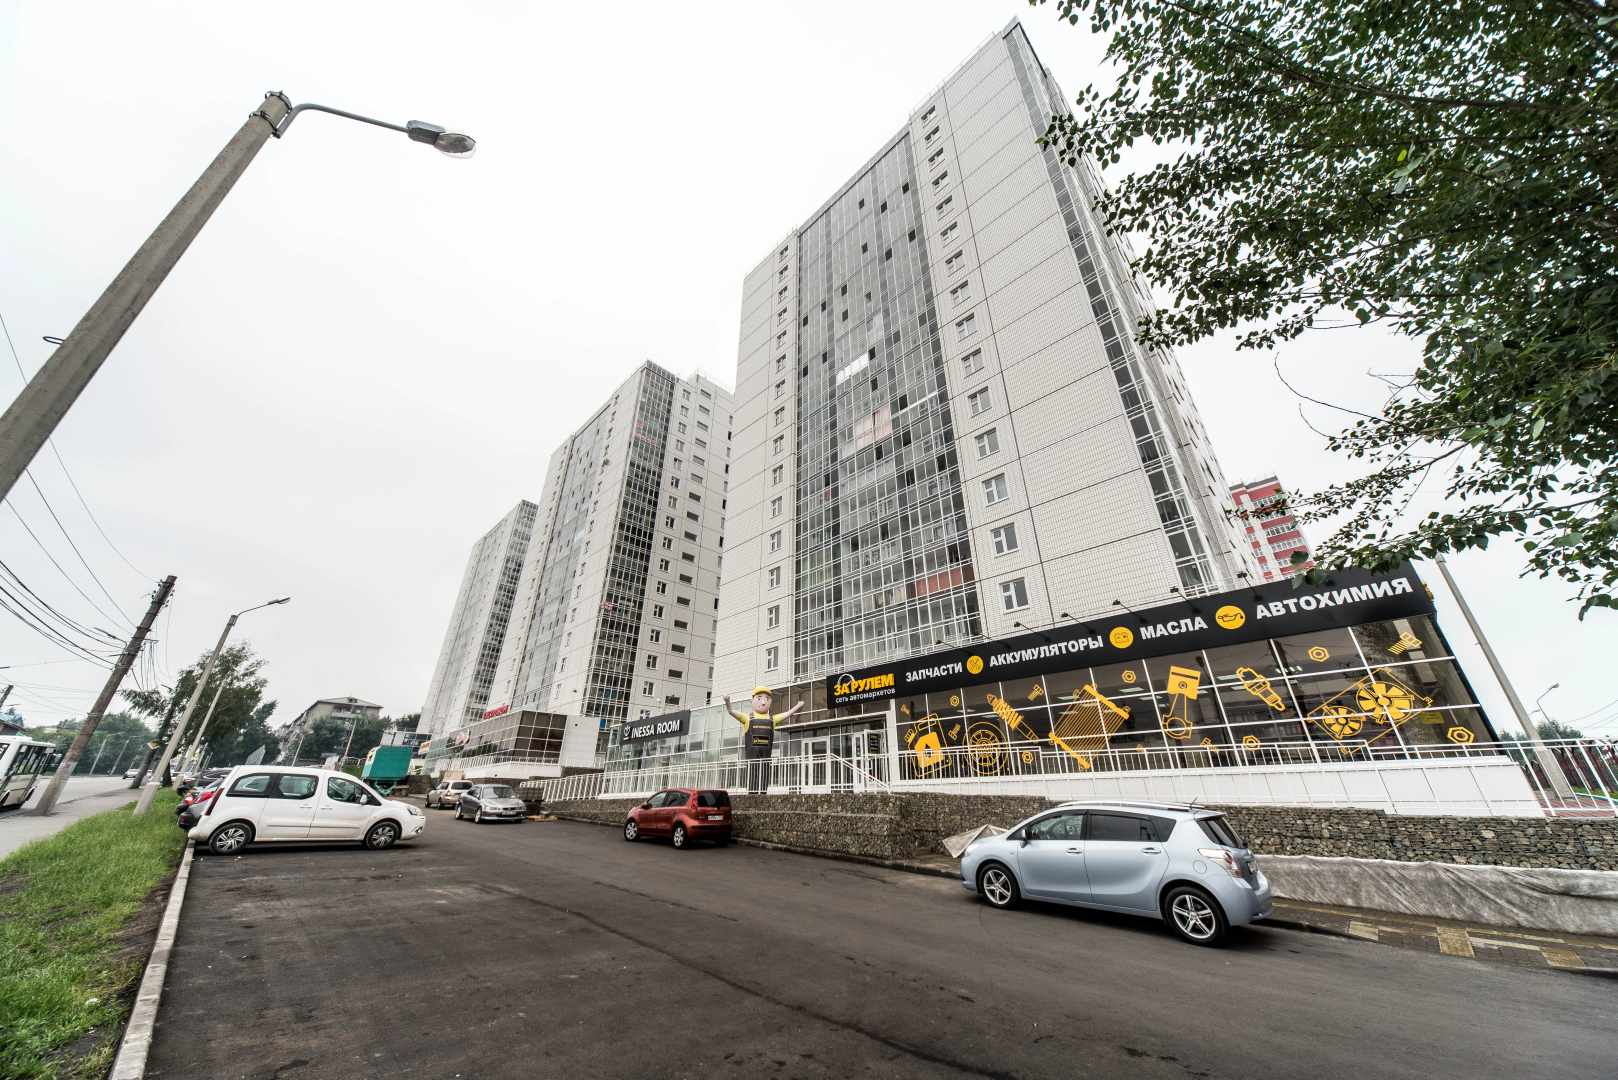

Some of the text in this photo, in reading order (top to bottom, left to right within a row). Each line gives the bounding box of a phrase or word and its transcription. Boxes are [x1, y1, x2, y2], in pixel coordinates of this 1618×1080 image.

[905, 577, 1414, 683] ЗАПЧАСТИ АККУМУЛЯТОРЫ МАСЛА АВТОХИМИЯ
[834, 673, 895, 696] ЗА РУЛЕМ
[849, 687, 896, 702] автомаркетов
[630, 719, 682, 739] INESSA ROOM
